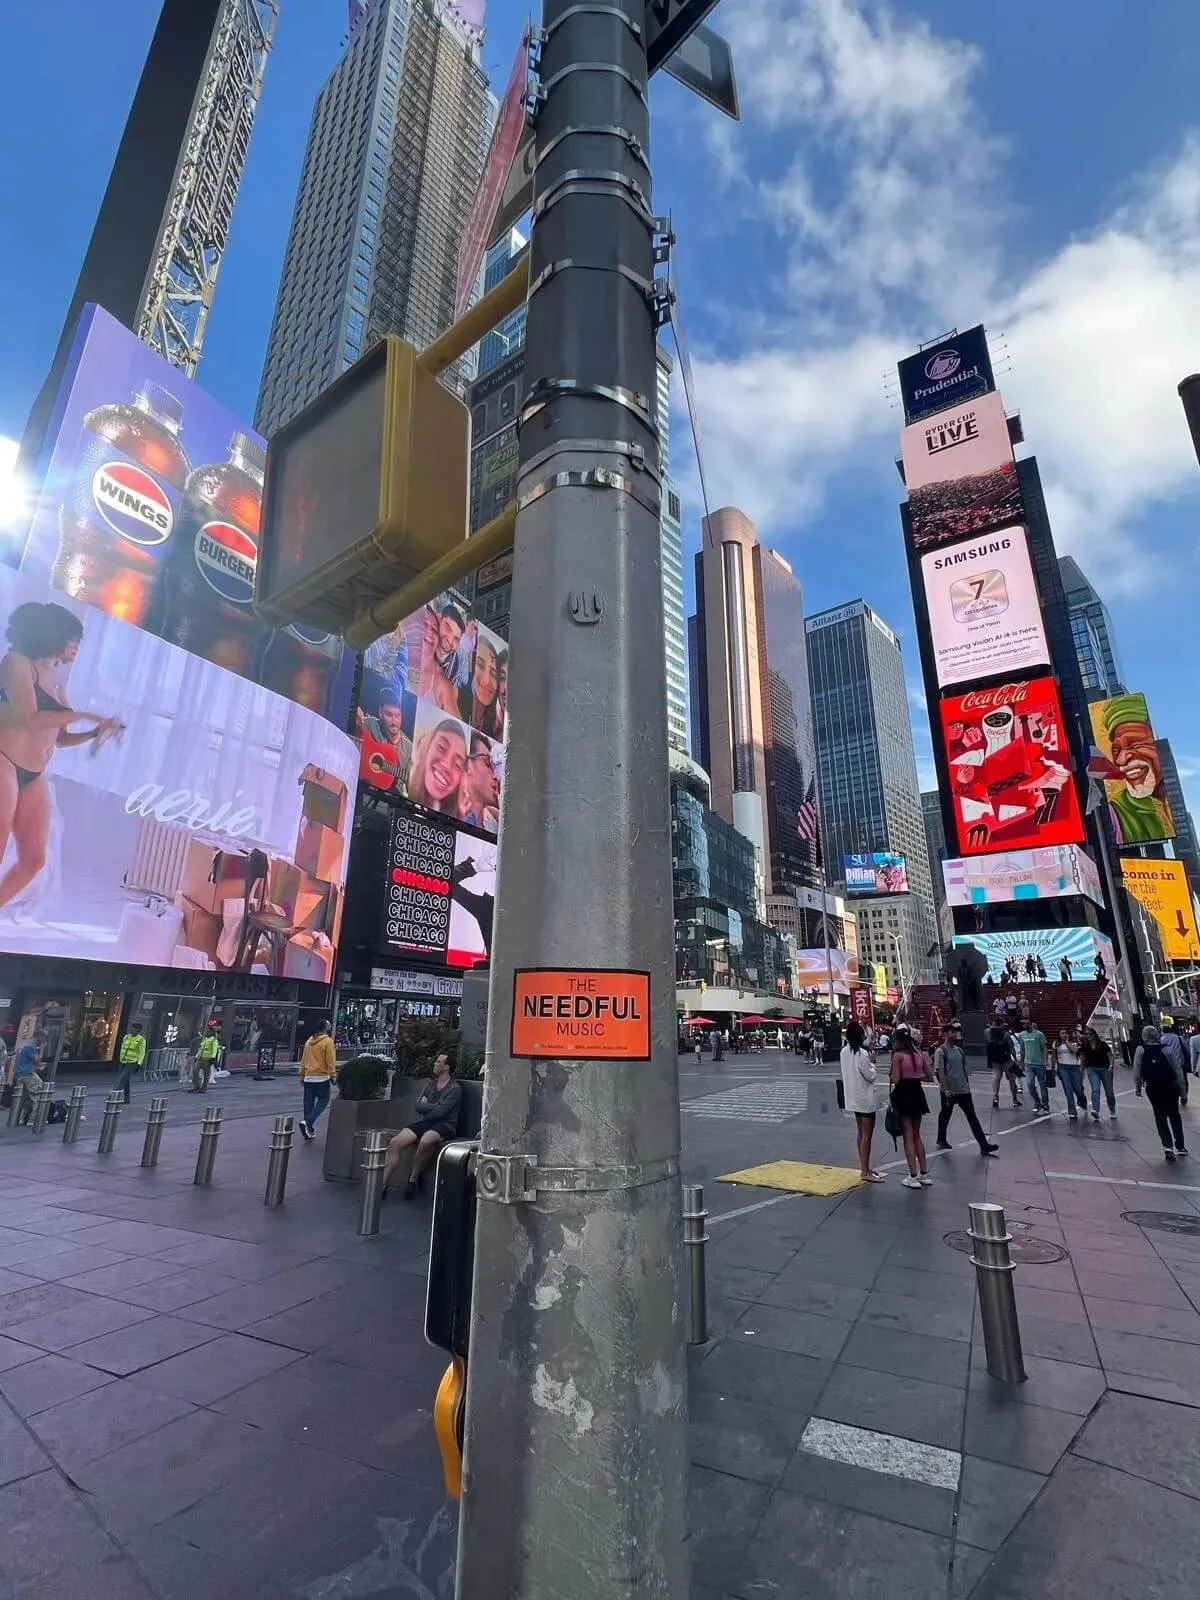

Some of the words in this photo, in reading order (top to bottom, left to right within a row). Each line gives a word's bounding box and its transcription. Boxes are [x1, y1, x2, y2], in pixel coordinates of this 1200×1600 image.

[914, 366, 978, 400] Prudential
[925, 421, 955, 436] RYDER
[958, 412, 976, 425] CUP
[927, 419, 978, 451] LIVE
[99, 476, 169, 530] WINGS
[934, 539, 1011, 570] SAMSUNG
[969, 579, 985, 600] 7
[812, 613, 841, 628] Allianz
[939, 643, 971, 656] Samsung
[972, 637, 993, 646] Vision
[1020, 626, 1037, 635] here
[125, 783, 256, 836] aerie
[397, 817, 453, 848] CHICAGO
[396, 834, 452, 864] CHICAGO
[394, 851, 450, 879] CHICAGO
[1122, 871, 1158, 879] come
[1160, 870, 1176, 880] in
[392, 867, 450, 895] CHICAGO
[1139, 881, 1157, 893] the
[391, 885, 448, 911] CHICAGO
[389, 903, 447, 928] CHICAGO
[387, 920, 446, 944] CHICAGO
[567, 979, 596, 991] THE
[408, 1003, 441, 1016] GRAND
[524, 995, 640, 1019] NEEDFUL
[855, 990, 867, 1019] tkts
[556, 1023, 605, 1036] MUSIC
